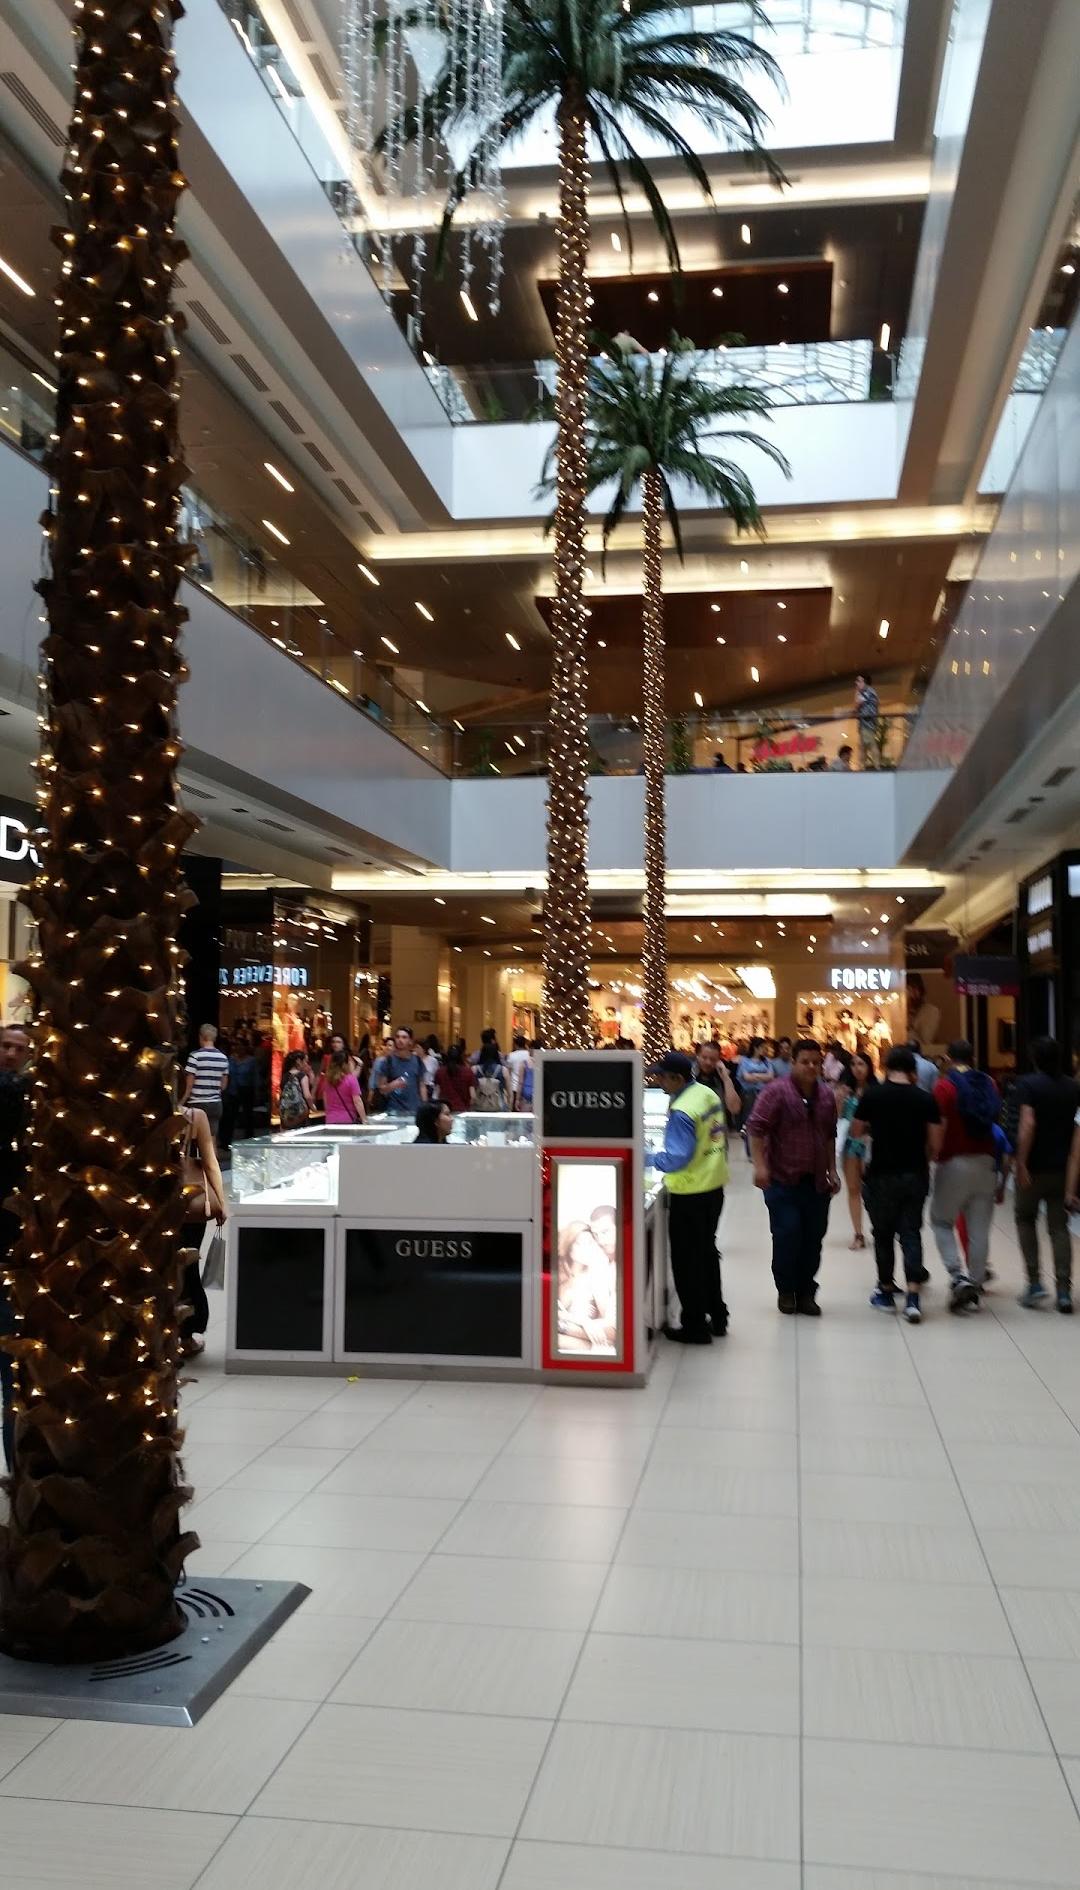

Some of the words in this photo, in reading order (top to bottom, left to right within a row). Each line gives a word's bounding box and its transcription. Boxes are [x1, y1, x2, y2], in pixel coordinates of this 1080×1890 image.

[831, 968, 892, 990] FOREV
[550, 1090, 627, 1110] GUESS
[395, 1239, 473, 1259] GUESS
